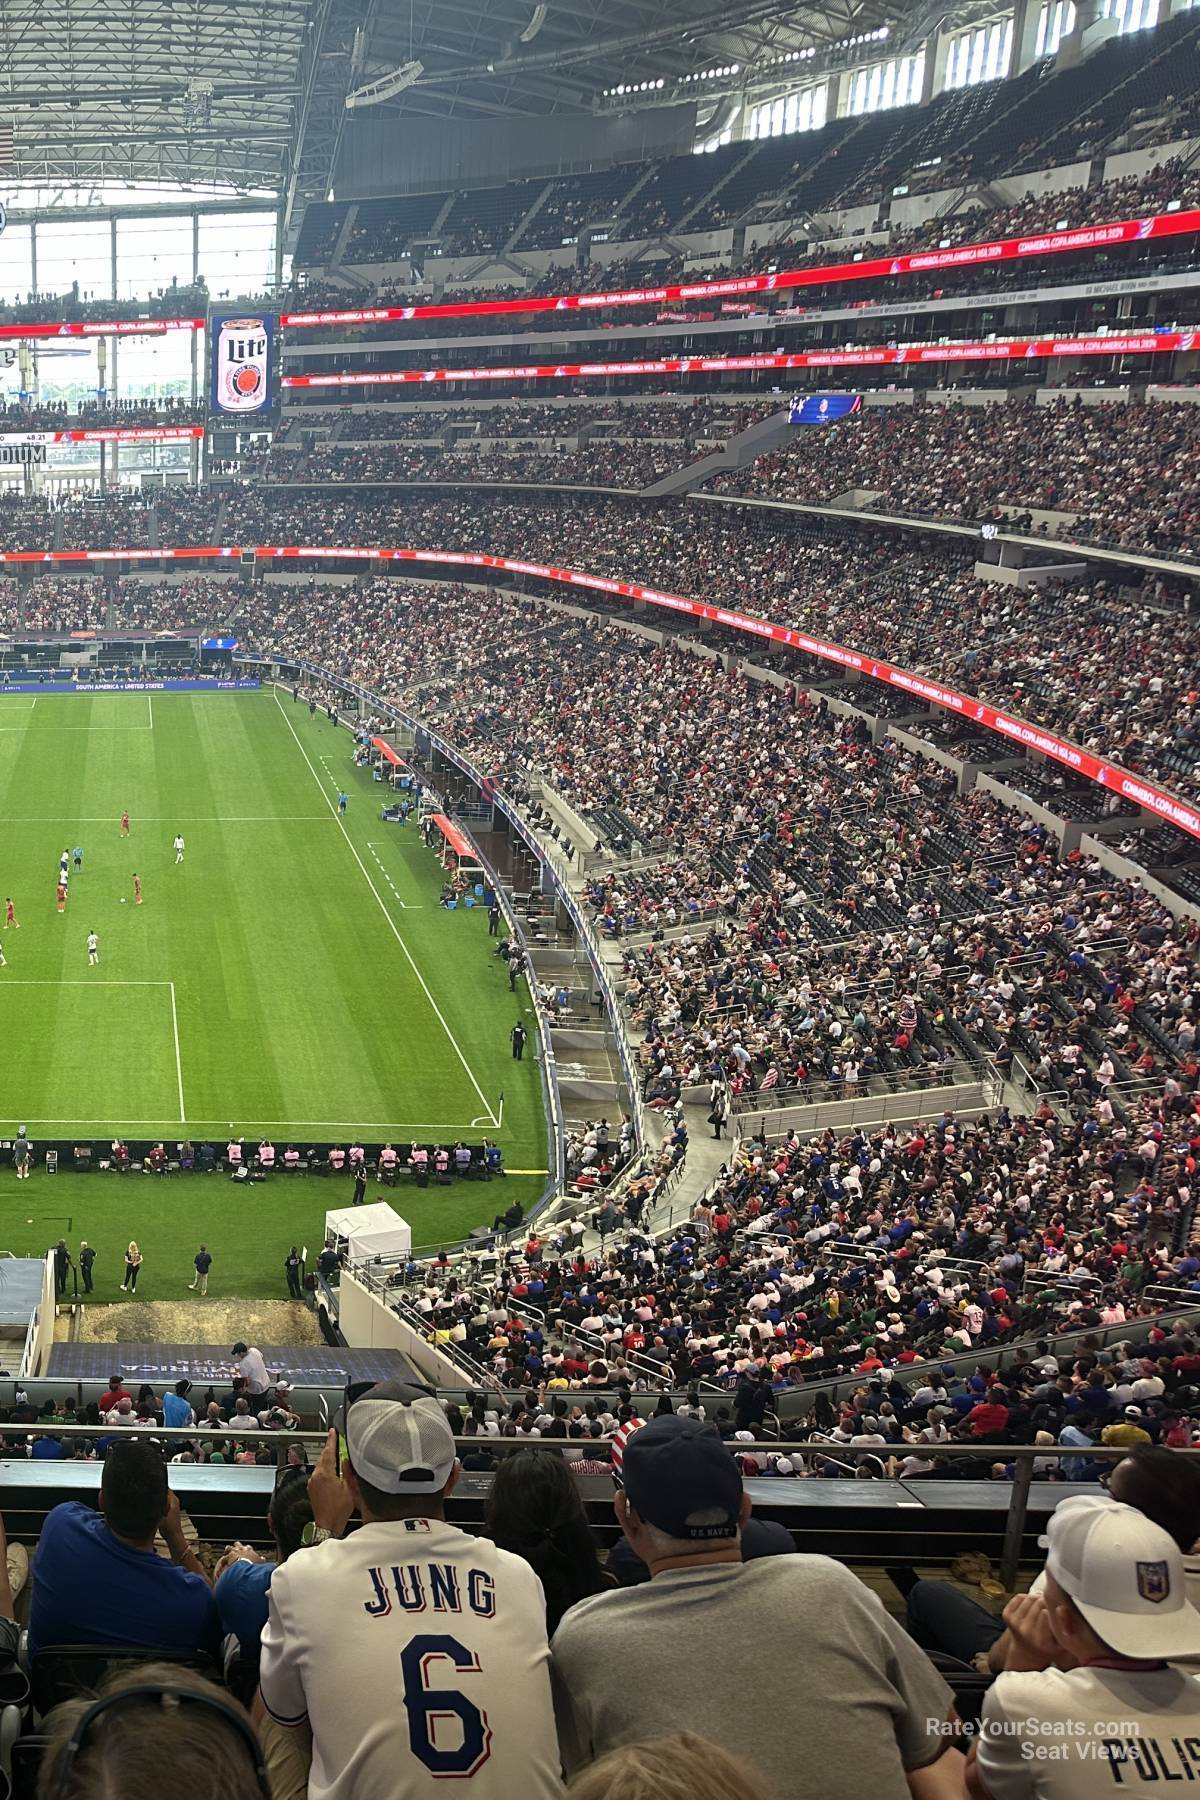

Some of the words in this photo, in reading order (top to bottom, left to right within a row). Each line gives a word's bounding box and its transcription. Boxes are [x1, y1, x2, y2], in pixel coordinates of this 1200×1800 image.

[228, 339, 266, 364] Lite
[707, 1528, 730, 1536] NAVY
[364, 1563, 496, 1619] JUNG
[400, 1634, 492, 1778] 6
